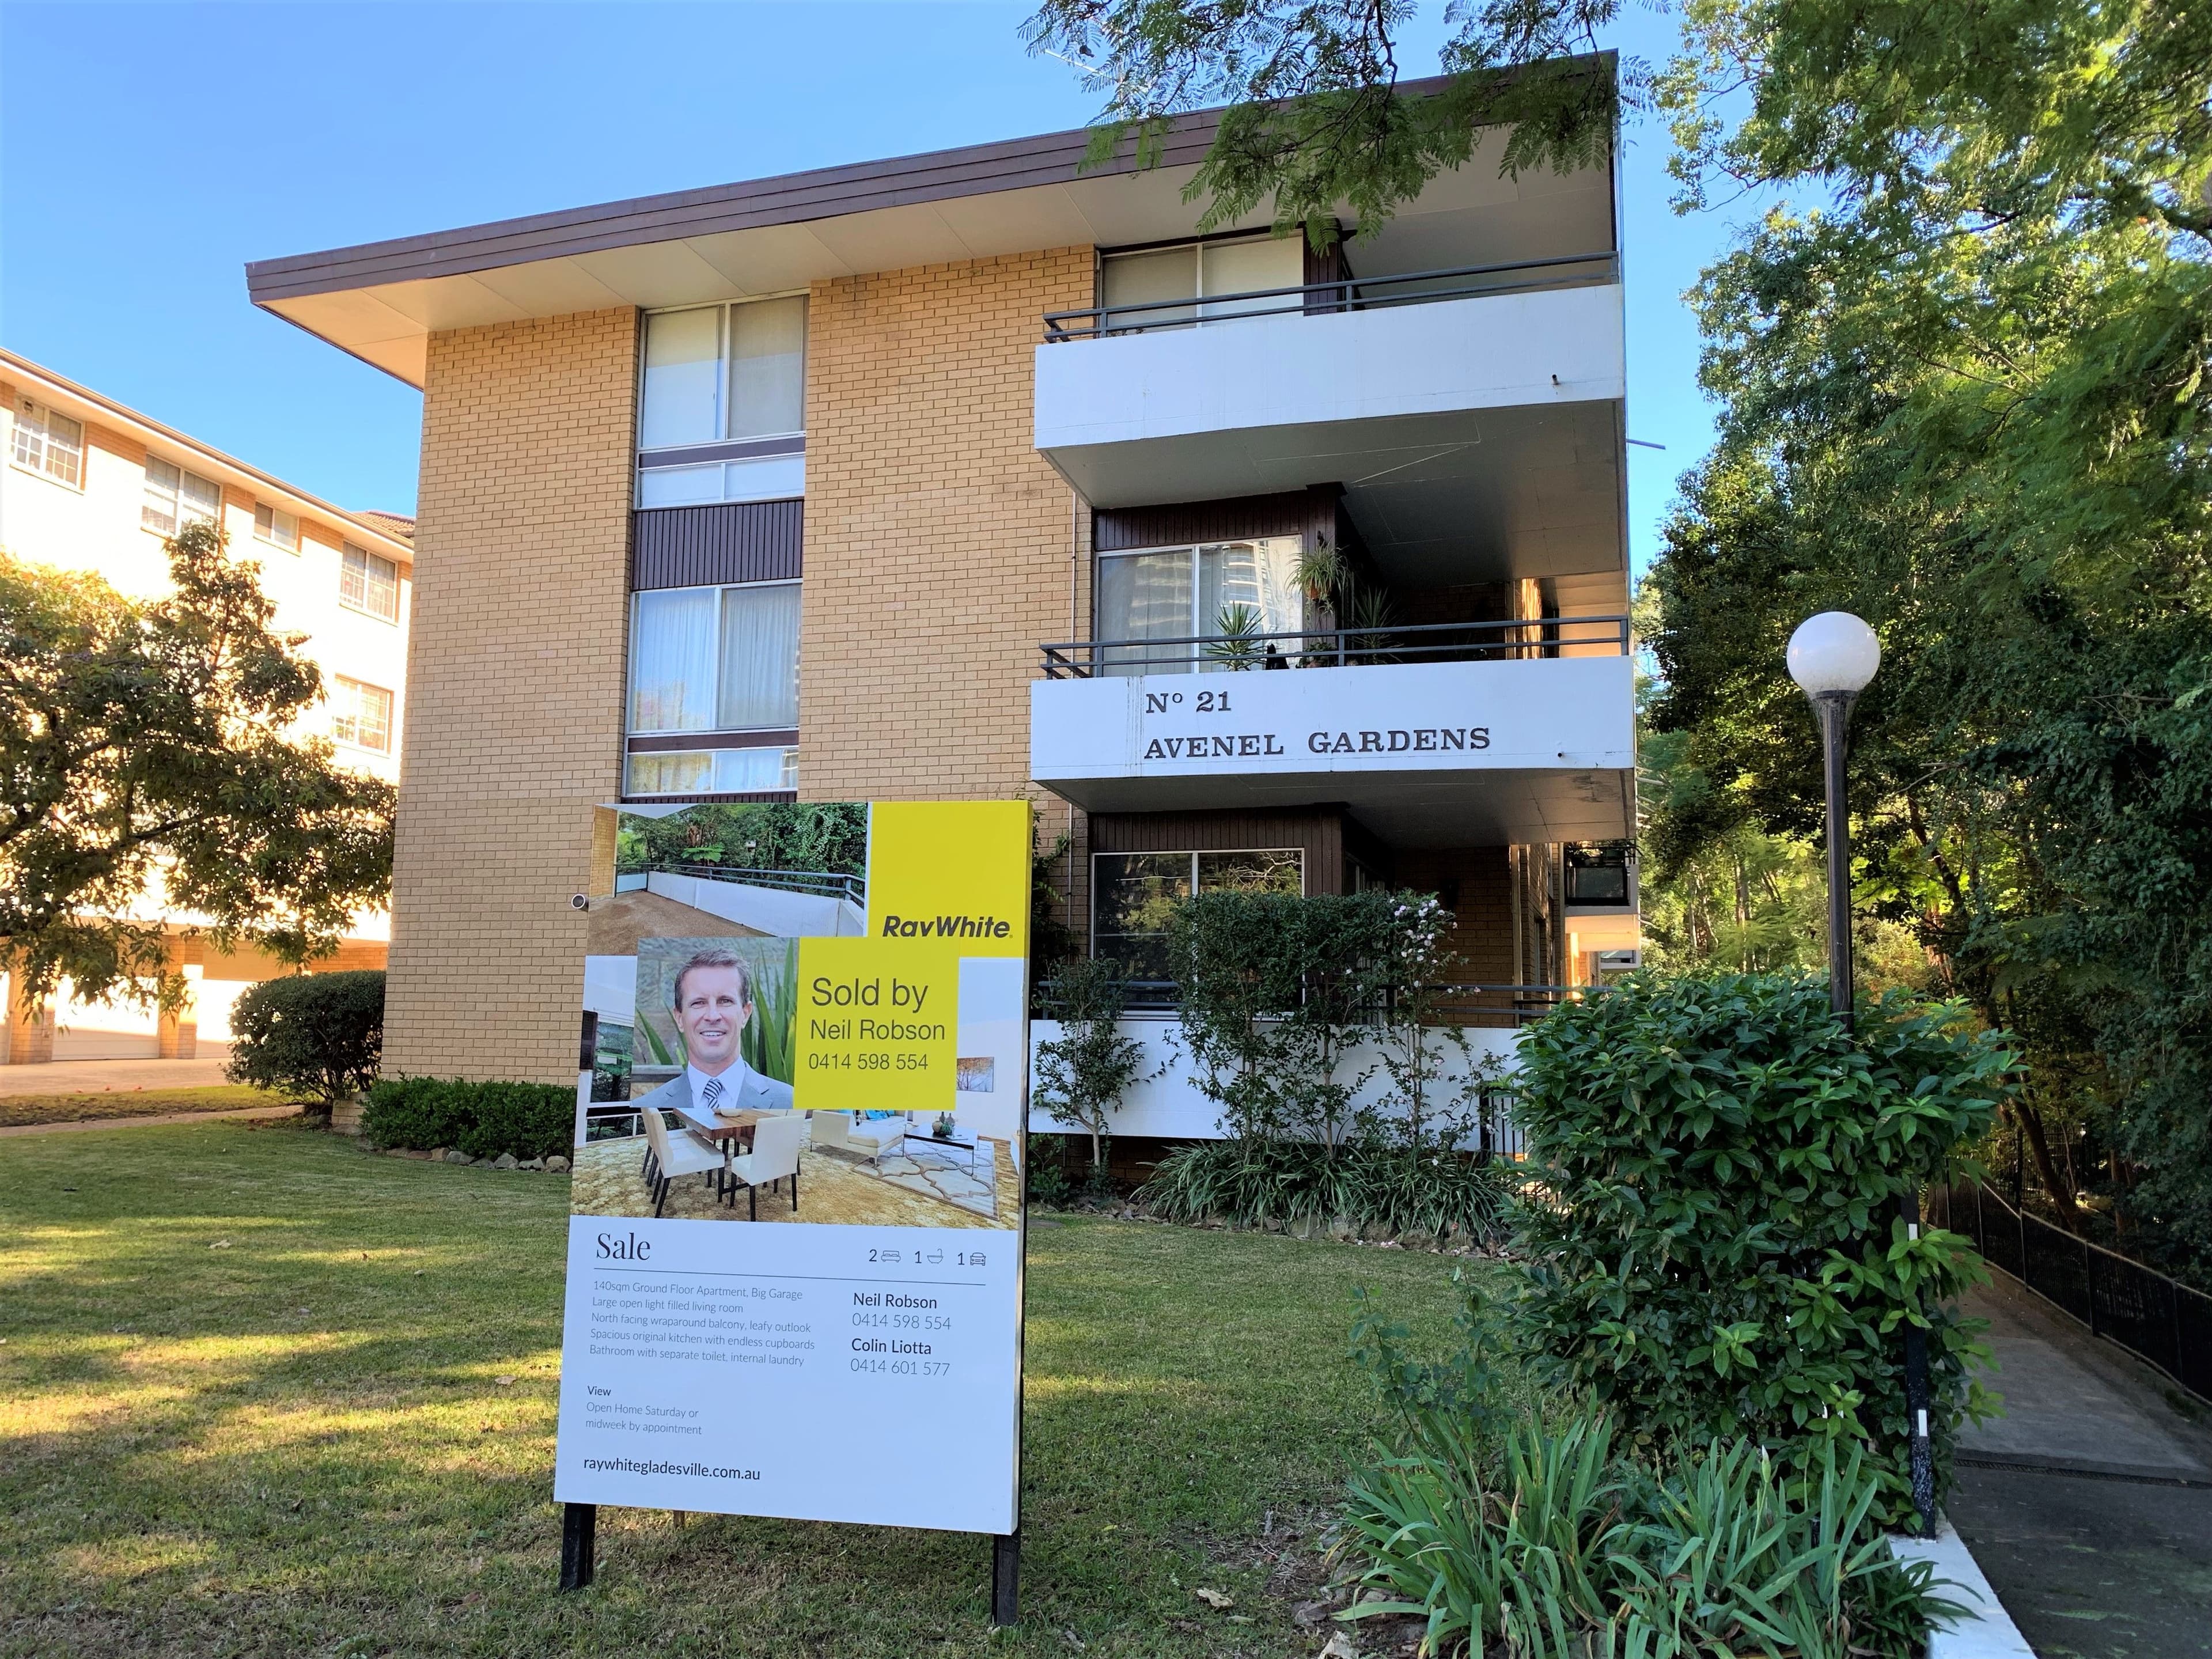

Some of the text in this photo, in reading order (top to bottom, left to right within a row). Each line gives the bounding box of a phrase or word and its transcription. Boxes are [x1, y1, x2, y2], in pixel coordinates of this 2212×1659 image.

[1196, 691, 1232, 713] 21
[1143, 727, 1490, 760] AVENEL GARDENS
[812, 977, 929, 1014] Sold by
[810, 1019, 945, 1040] Neil Robson
[809, 1053, 929, 1070] 0414 598 554
[596, 1232, 650, 1260] Sale
[869, 1249, 965, 1266] 2 1 1
[594, 1281, 630, 1294] 140sqm
[632, 1282, 668, 1293] Ground
[670, 1283, 695, 1294] Floor
[751, 1287, 767, 1300] Big
[768, 1288, 802, 1301] Garage
[854, 1292, 937, 1309] Neil Robson
[592, 1297, 743, 1314] Large open light filled living room
[592, 1312, 811, 1332] North facing wraparound balcony, leafy outlook
[852, 1312, 952, 1330] 0414 598 554
[590, 1328, 815, 1350] Spacious original kitchen with endless cupboards
[851, 1338, 931, 1355] Colin Liotta
[590, 1344, 635, 1356] Bathroom
[637, 1348, 657, 1358] with
[660, 1350, 699, 1360] separate
[730, 1354, 766, 1363] internal
[769, 1354, 805, 1368] laundry
[850, 1358, 950, 1376] 0414 601 577
[587, 1385, 611, 1396] View
[586, 1402, 699, 1419] Open Home Saturday or
[585, 1419, 702, 1435] midweek by appointment
[584, 1457, 760, 1480] raywhitegladesville.com.au
